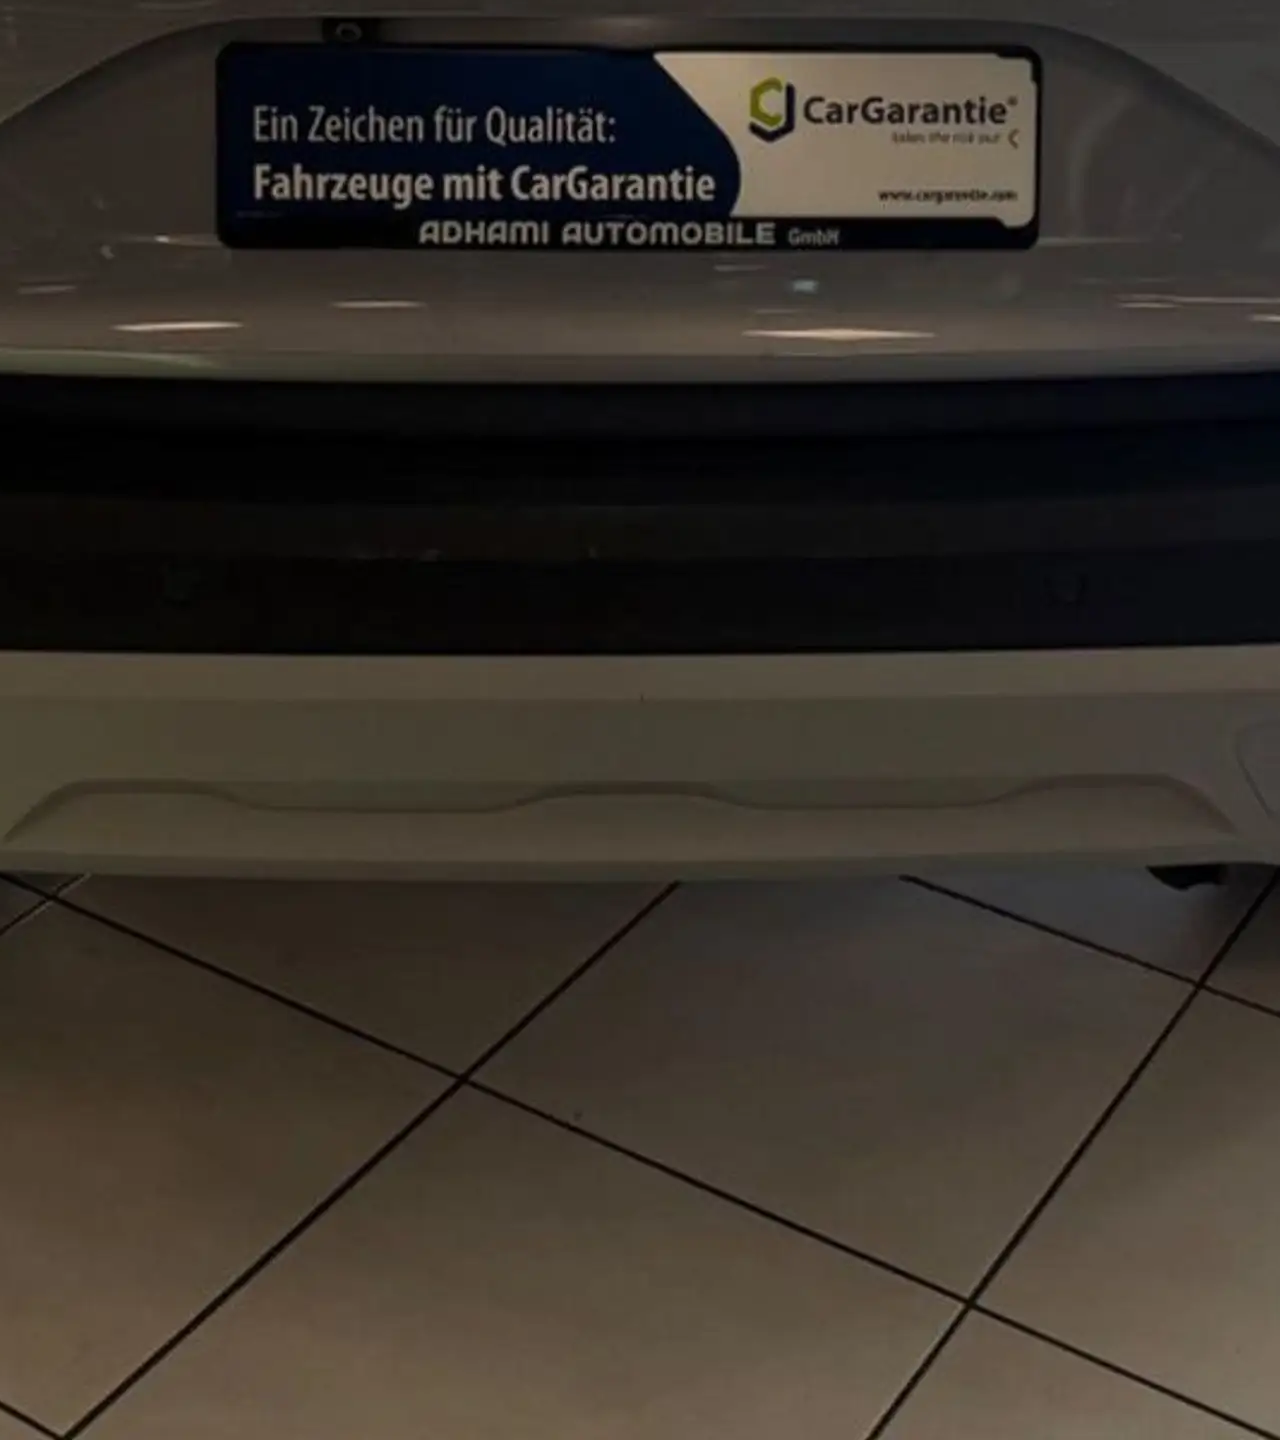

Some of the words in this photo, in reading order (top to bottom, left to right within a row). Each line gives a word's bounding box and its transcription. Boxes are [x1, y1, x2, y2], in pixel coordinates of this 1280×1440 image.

[253, 105, 298, 143] Ein
[307, 105, 424, 143] Zeichen
[433, 105, 478, 143] für
[485, 105, 617, 147] Qualität:
[253, 164, 433, 210] Fahrzeuge
[443, 165, 503, 201] mit
[511, 164, 716, 202] CarGarantie
[419, 220, 549, 246] ADHAMI
[562, 220, 776, 246] AUTOMOBILE
[787, 227, 841, 247] GmbH
